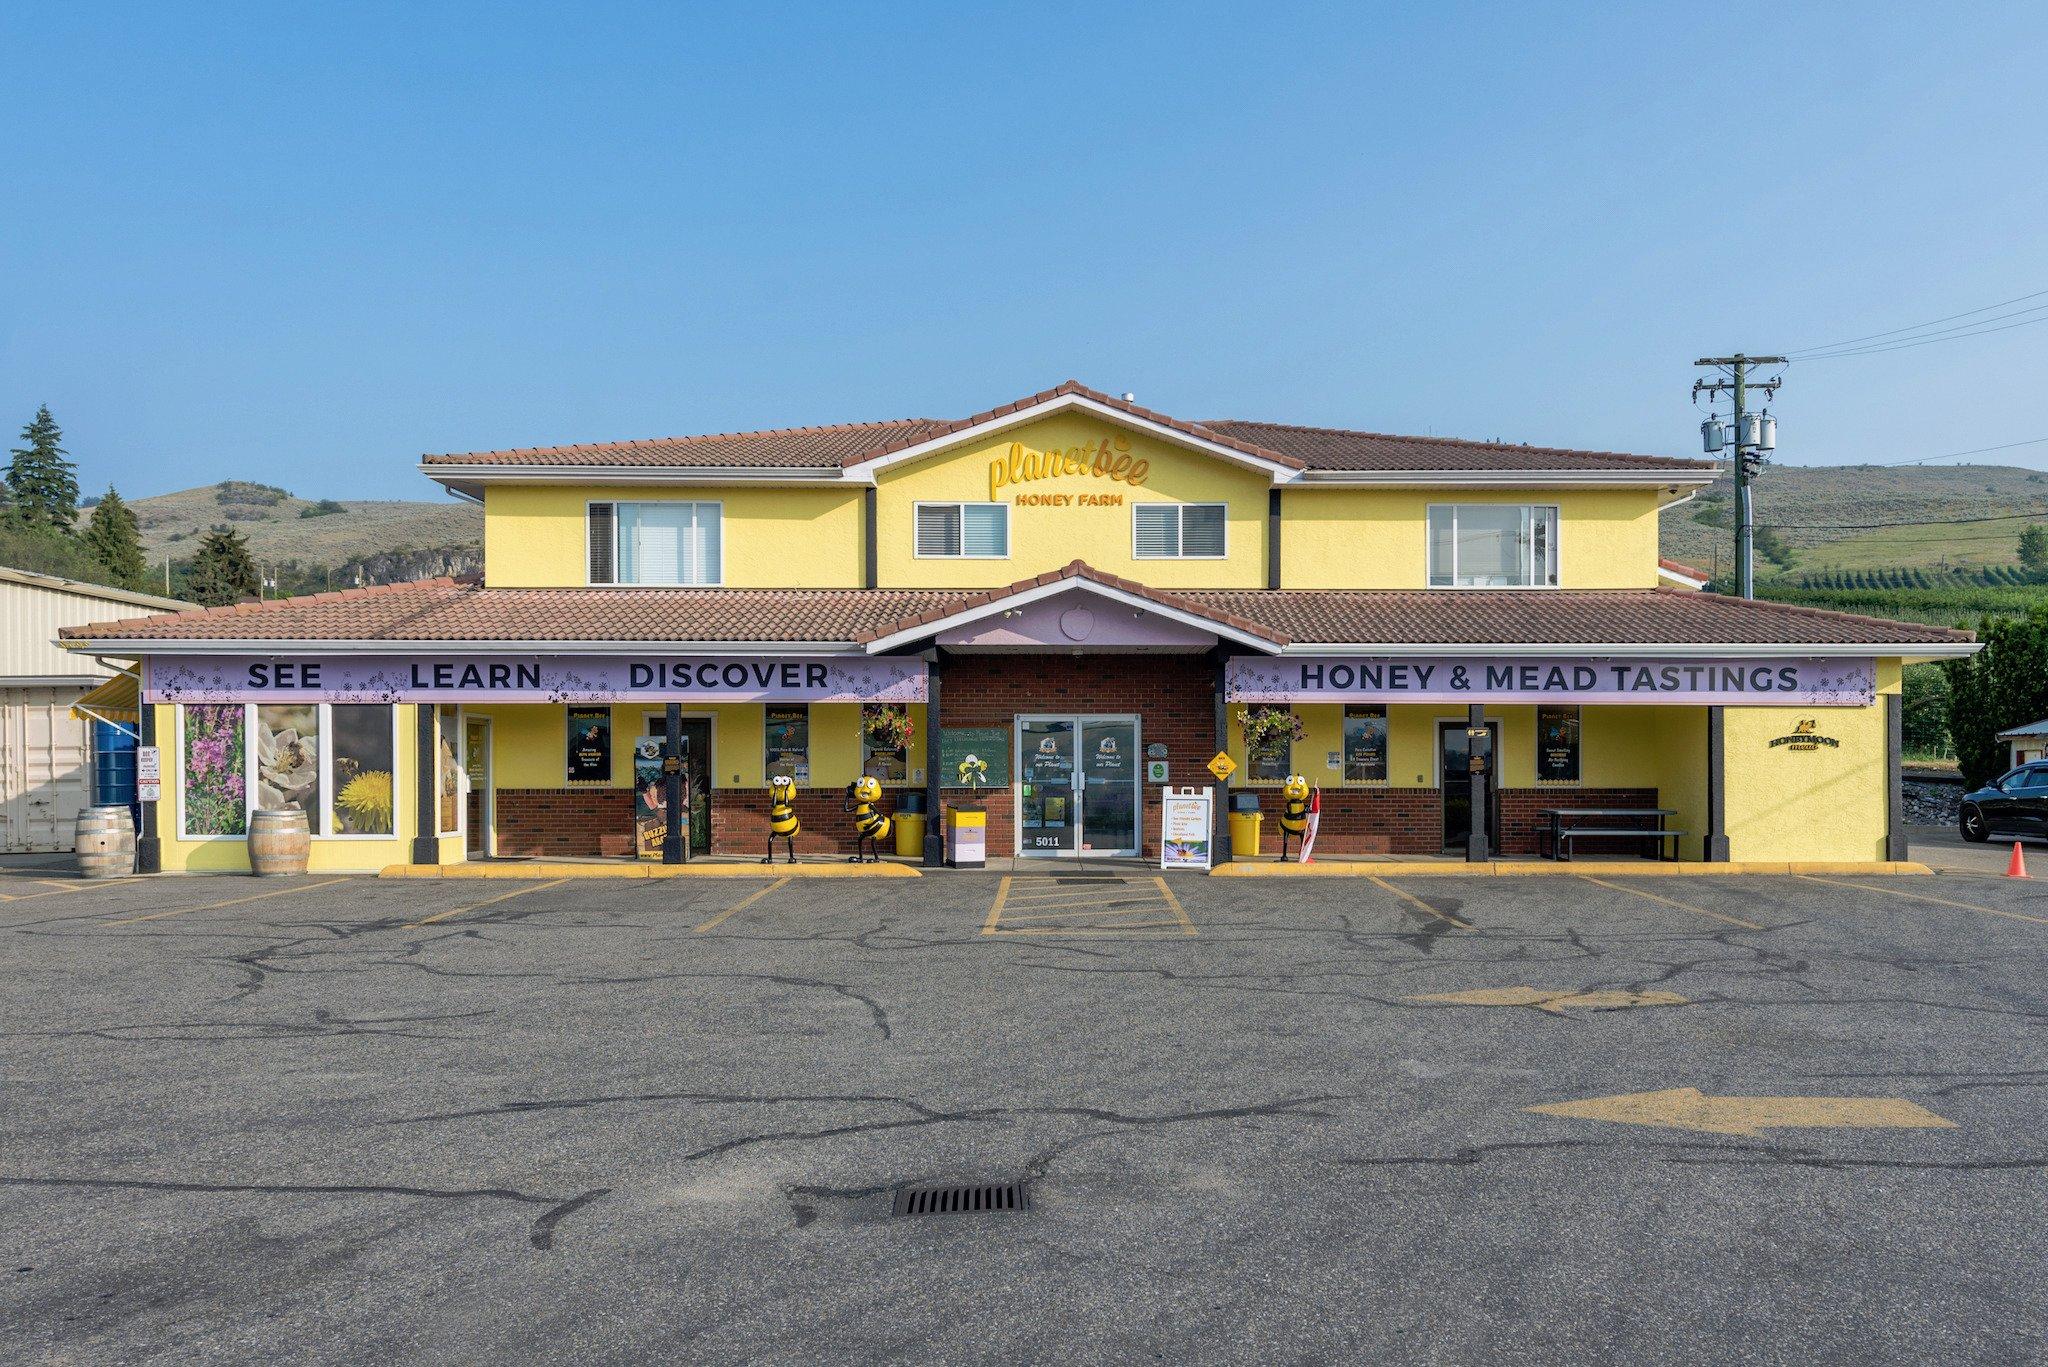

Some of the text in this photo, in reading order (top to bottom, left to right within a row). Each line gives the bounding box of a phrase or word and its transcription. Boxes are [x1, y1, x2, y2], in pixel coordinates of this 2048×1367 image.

[1015, 494, 1123, 507] HONEY FARM
[248, 663, 323, 688] SEE
[411, 664, 541, 688] LEARN
[630, 663, 828, 688] DISCOVER
[1301, 664, 1799, 692] HONEY & MEAD TASTINGS
[1769, 735, 1839, 748] HONEYMOON
[1035, 837, 1060, 847] 5011
